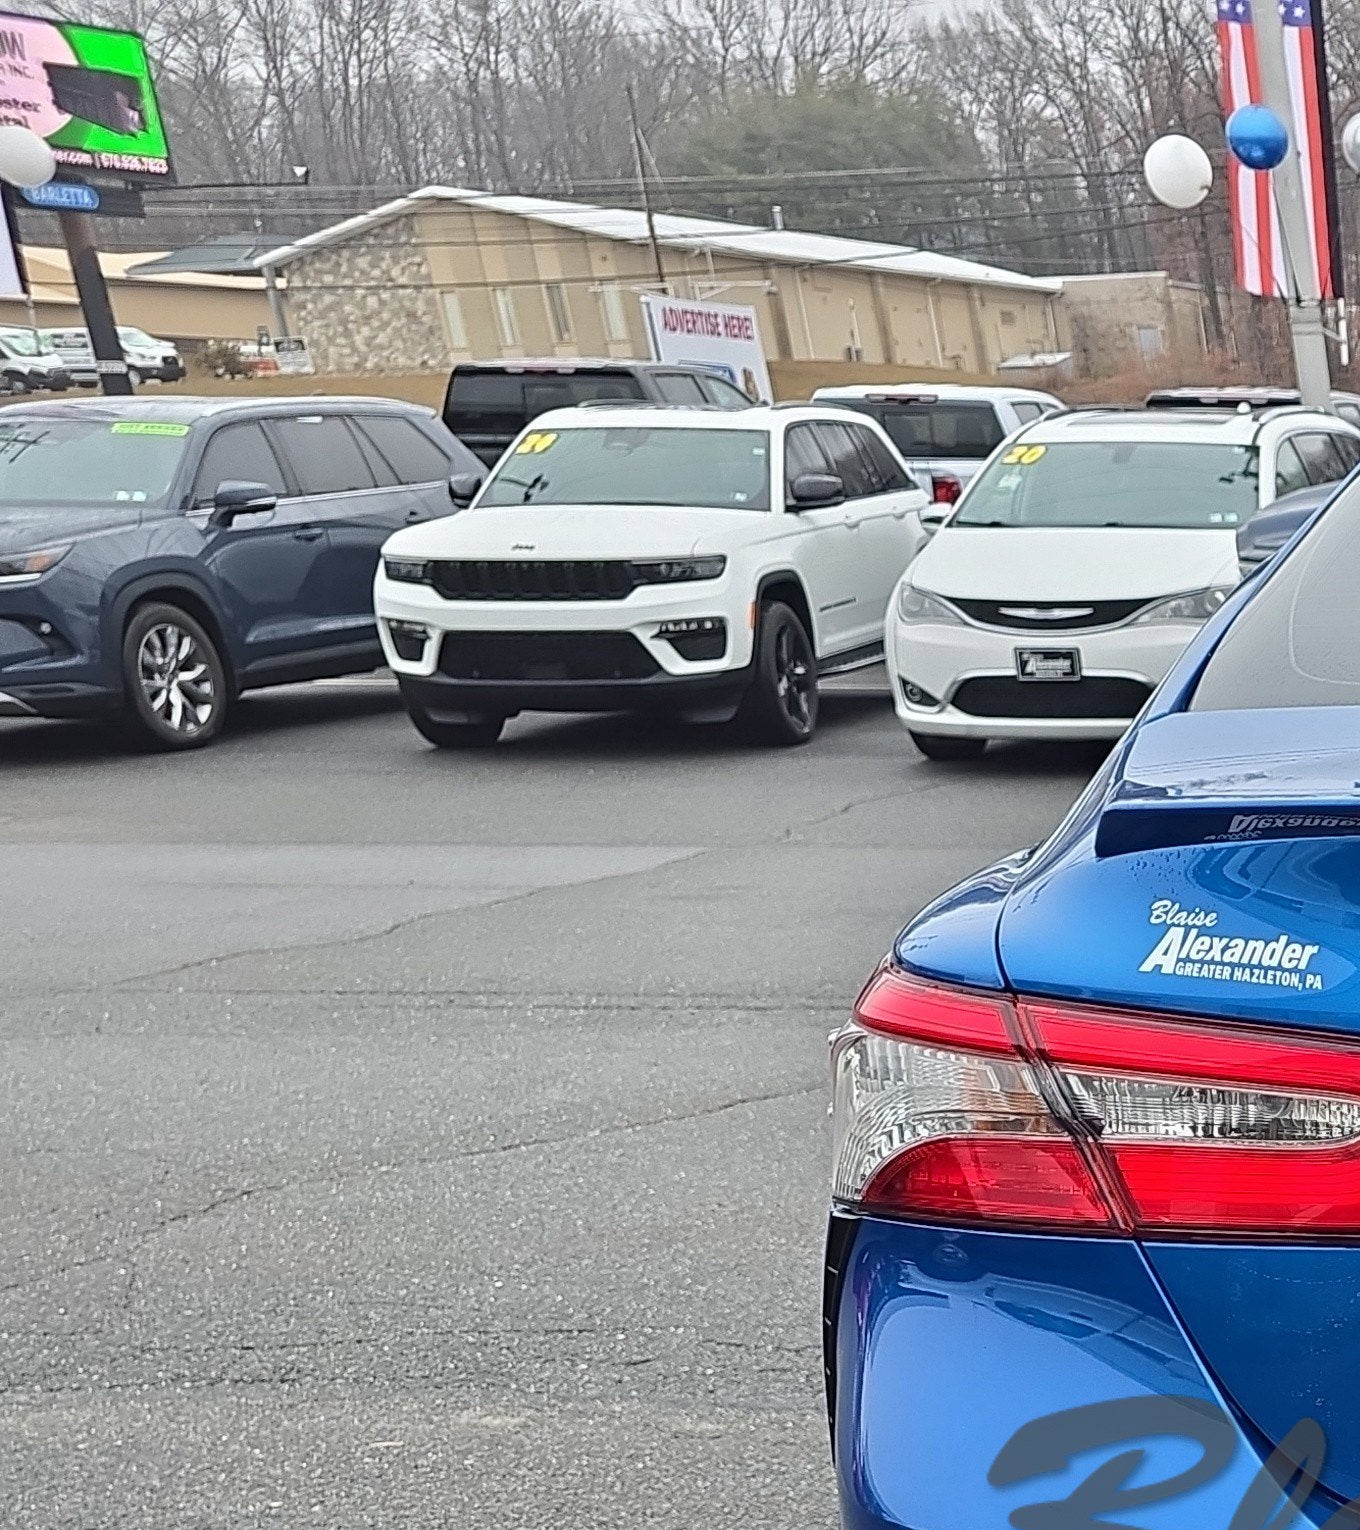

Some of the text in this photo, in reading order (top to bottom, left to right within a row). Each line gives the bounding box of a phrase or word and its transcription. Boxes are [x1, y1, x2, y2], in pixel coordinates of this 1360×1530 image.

[662, 306, 721, 337] ADVERTISE
[1003, 444, 1047, 465] 20
[1149, 899, 1218, 927] Blaise
[1138, 926, 1319, 974] Alexander
[1175, 961, 1324, 991] GREATER HAZLETON, PA
